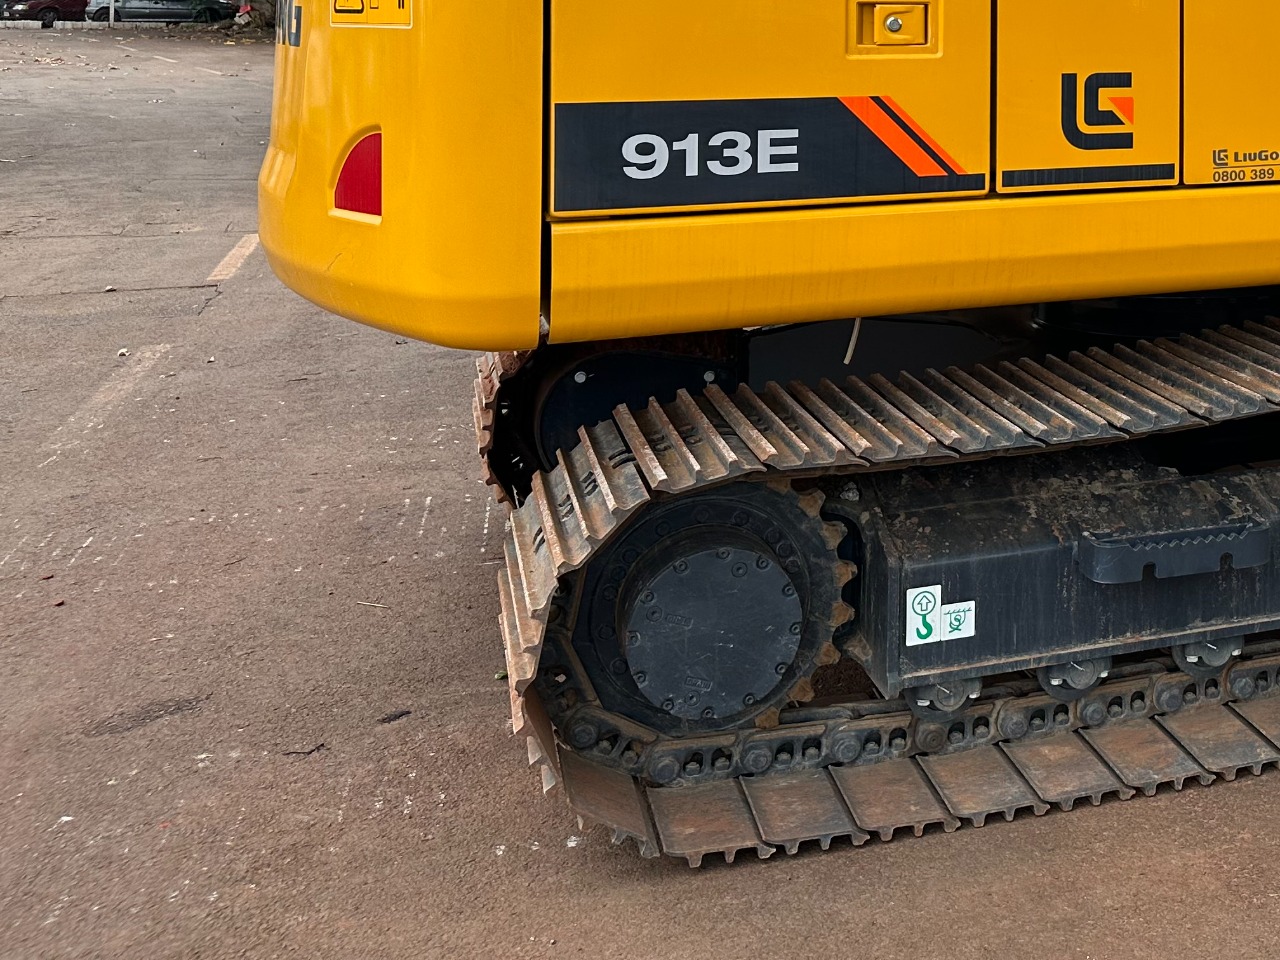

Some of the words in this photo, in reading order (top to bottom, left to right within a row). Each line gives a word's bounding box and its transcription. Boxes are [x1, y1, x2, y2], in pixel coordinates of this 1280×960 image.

[621, 128, 799, 179] 913E
[1213, 170, 1246, 182] 0800
[1250, 168, 1274, 180] 389
